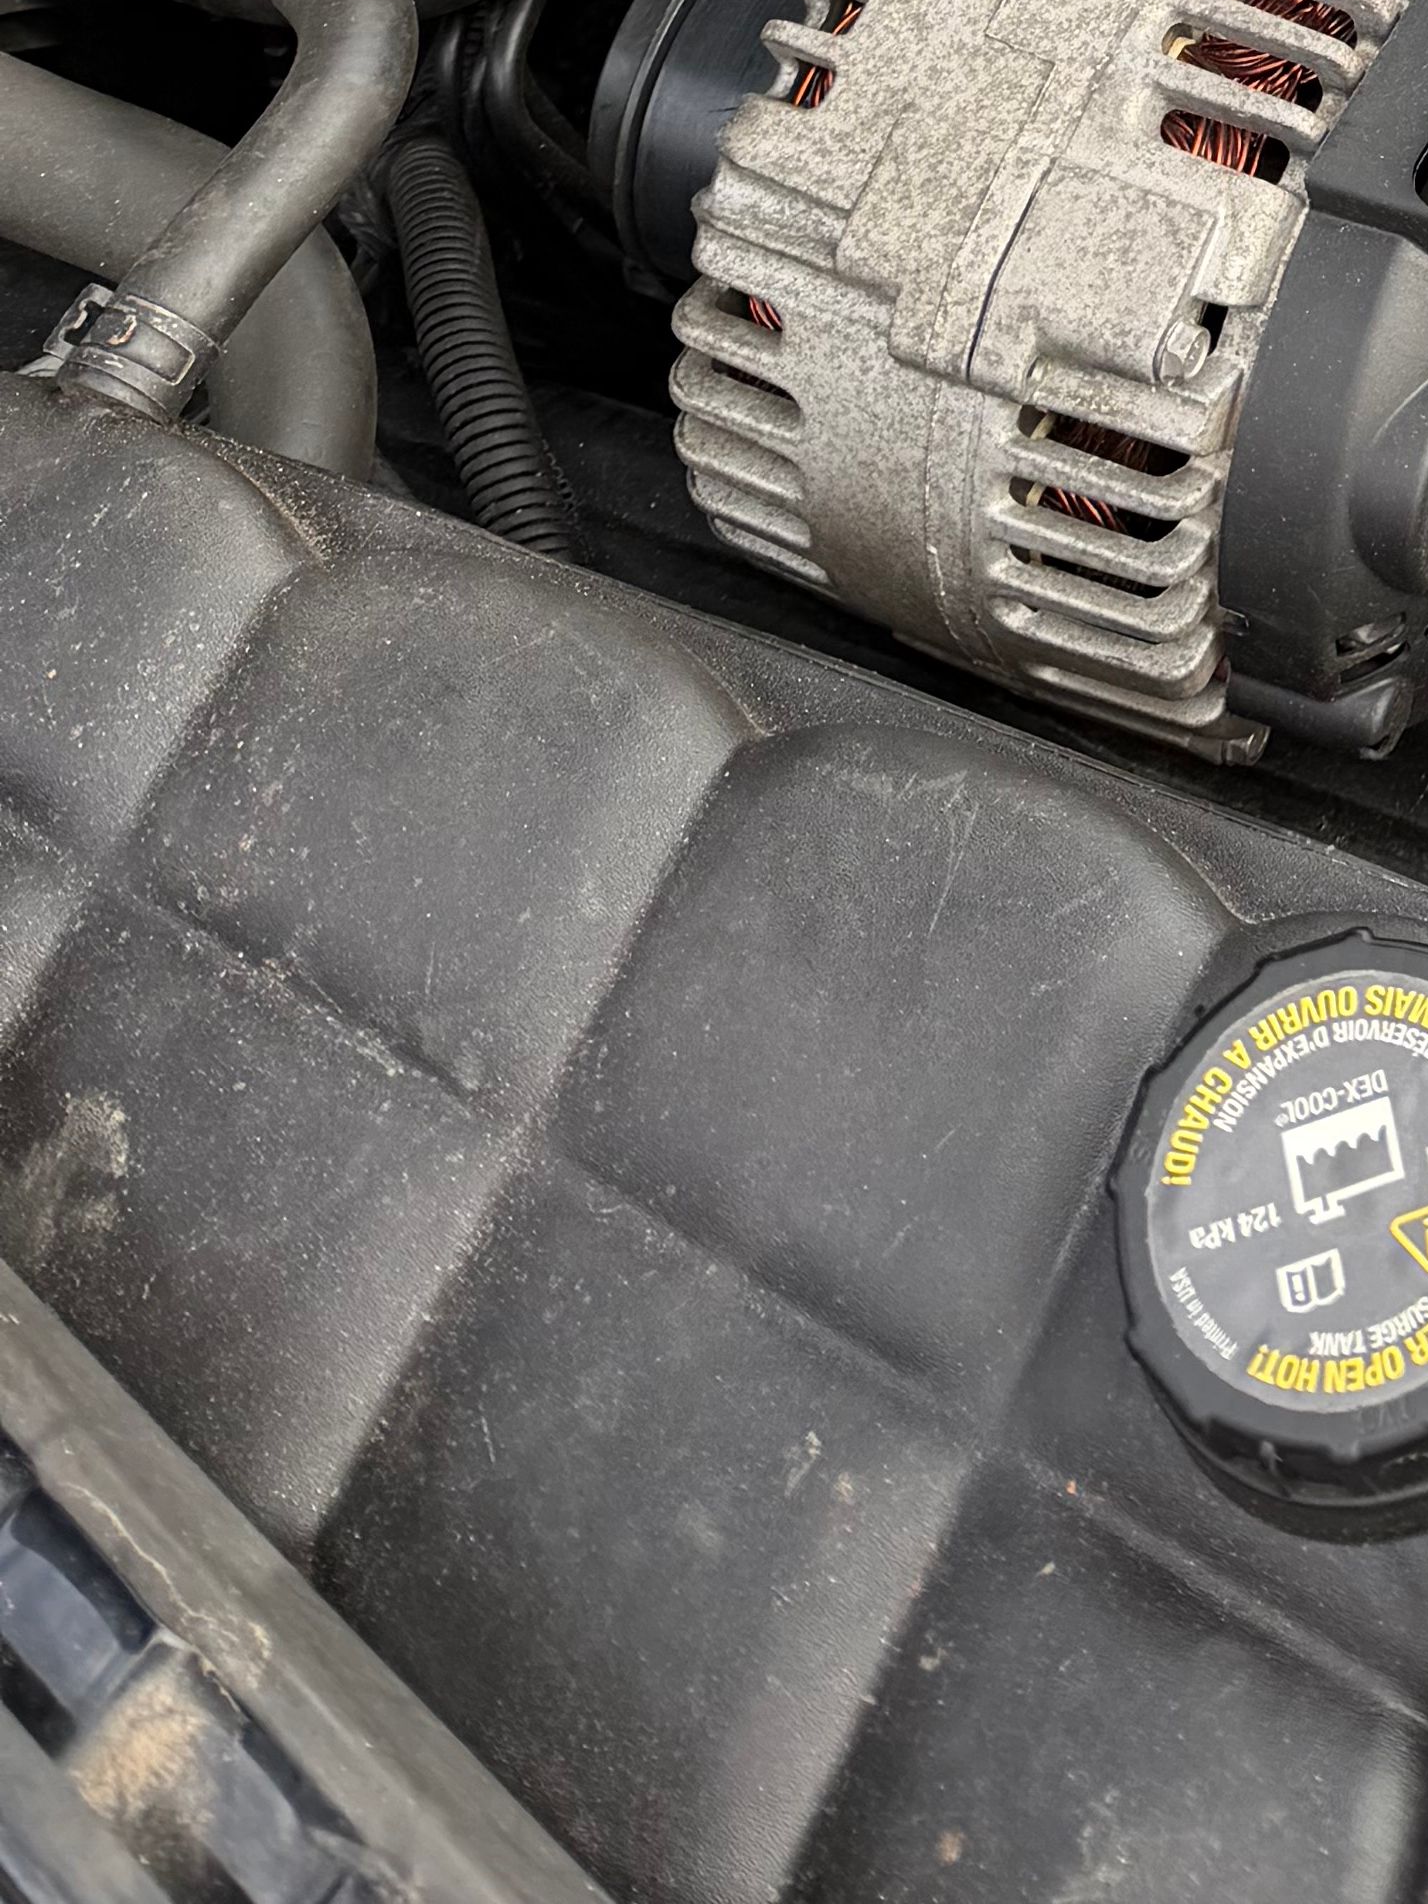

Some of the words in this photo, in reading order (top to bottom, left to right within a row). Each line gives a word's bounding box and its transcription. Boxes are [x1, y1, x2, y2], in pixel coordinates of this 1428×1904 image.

[1248, 985, 1359, 1051] OUVRIR
[1212, 1024, 1332, 1134] D'EXPANSION
[1222, 1039, 1252, 1071] A
[1160, 1066, 1234, 1187] CHAUD!
[1187, 1216, 1237, 1250] kPa
[1237, 1201, 1284, 1238] 124
[1168, 1265, 1198, 1305] USA
[1193, 1308, 1240, 1361] Printed
[1309, 1328, 1367, 1357] TANK
[1247, 1343, 1321, 1393] HOT!
[1323, 1344, 1406, 1394] OPEN
